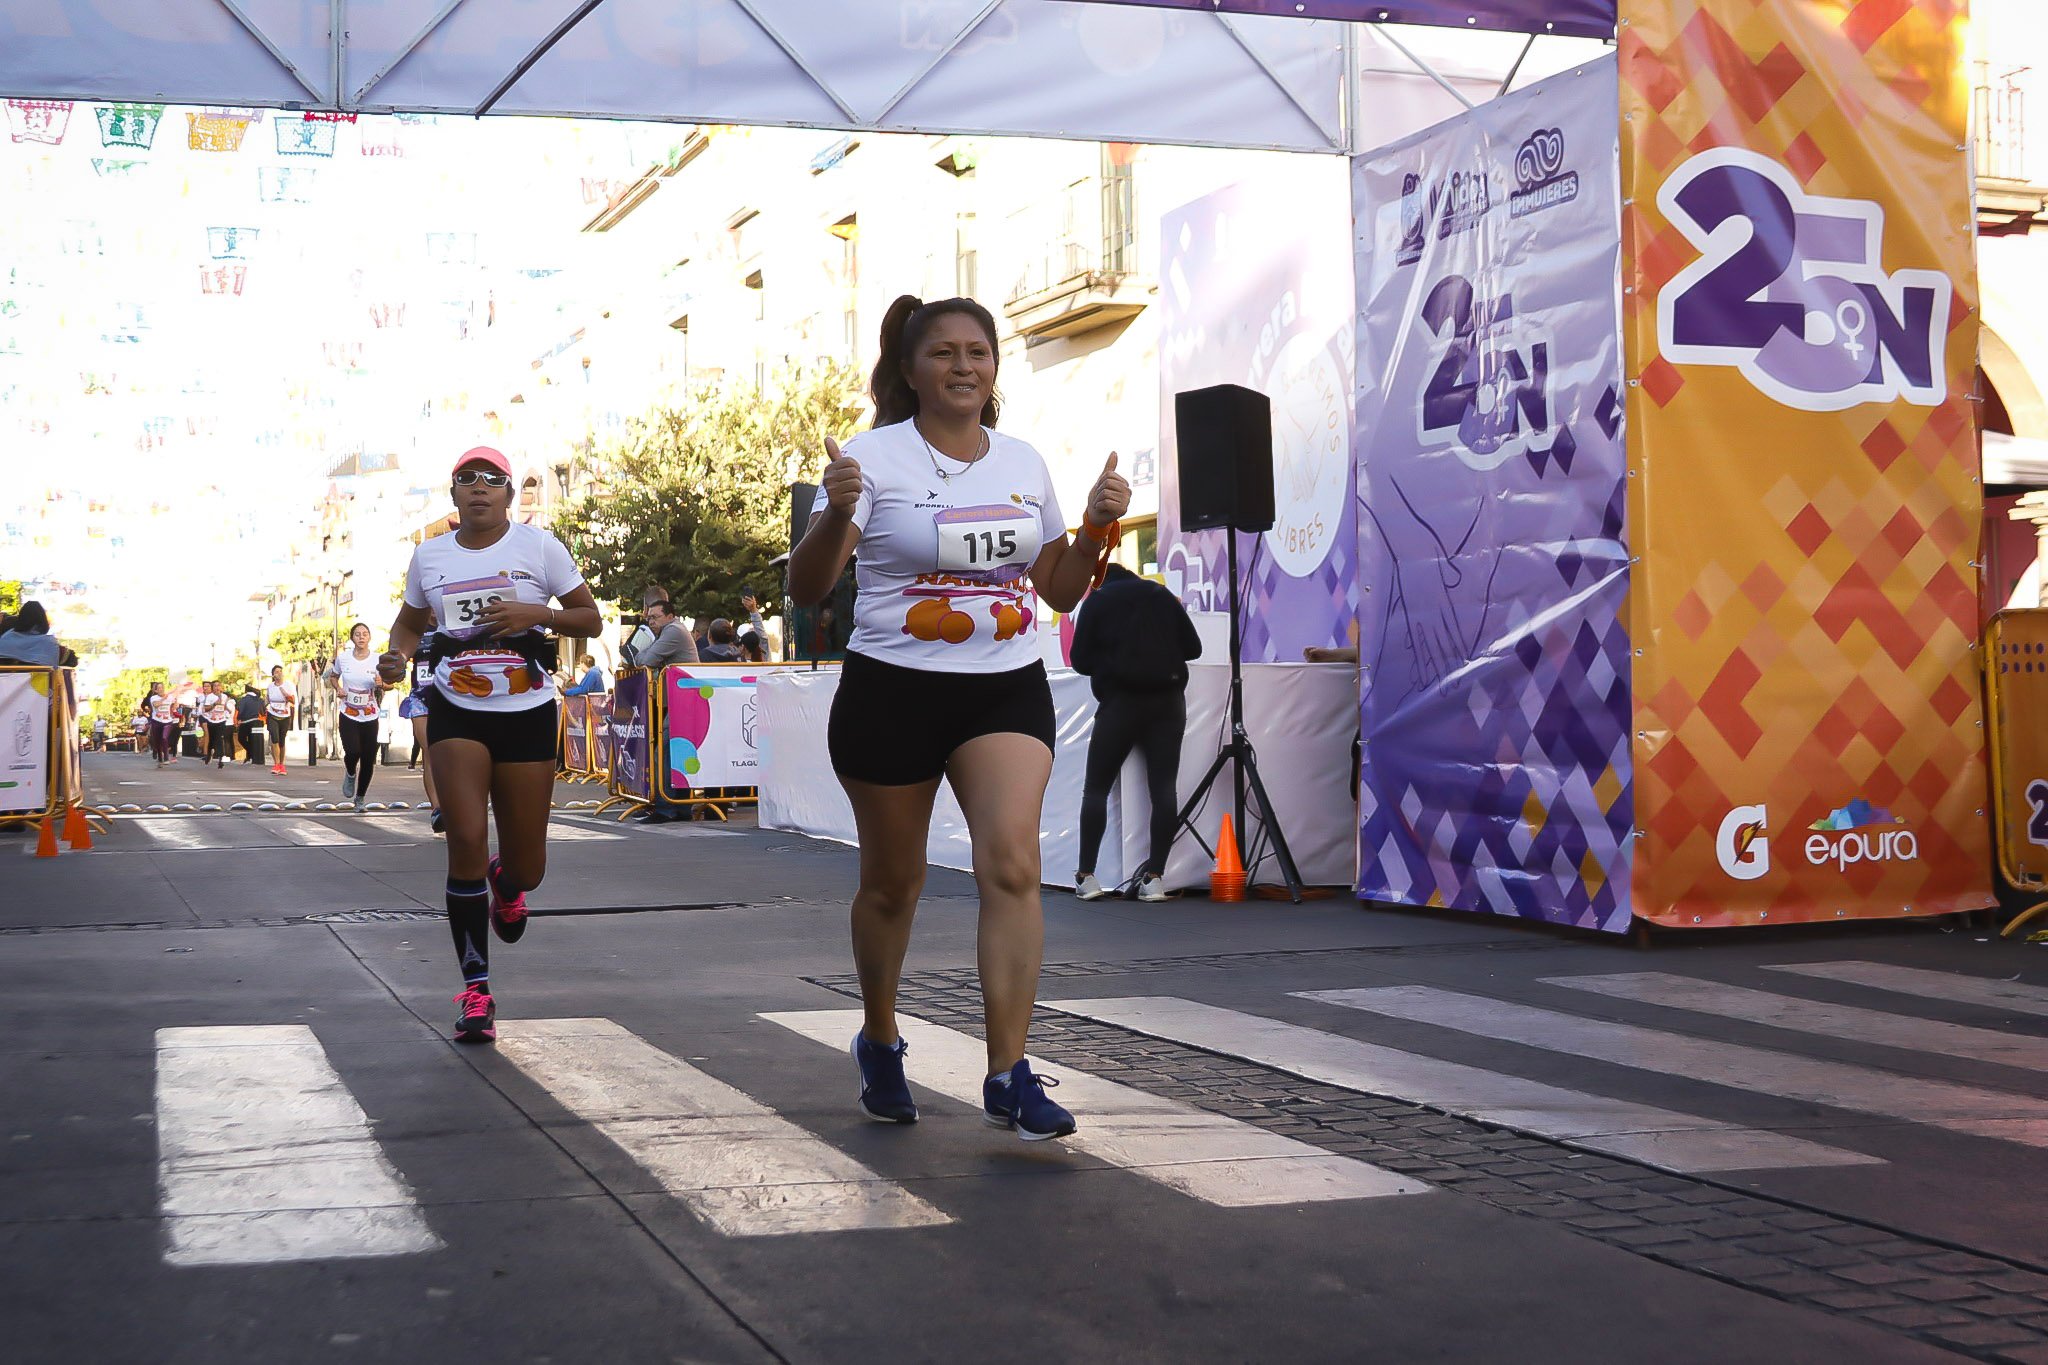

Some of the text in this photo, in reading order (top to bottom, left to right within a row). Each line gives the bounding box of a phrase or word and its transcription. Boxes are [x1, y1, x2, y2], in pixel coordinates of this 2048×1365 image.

[1666, 160, 1940, 396] 25N
[963, 529, 1017, 564] 115
[1276, 511, 1325, 555] LIBRES
[457, 596, 502, 622] 31
[353, 696, 362, 704] 61
[1716, 804, 1770, 880] G
